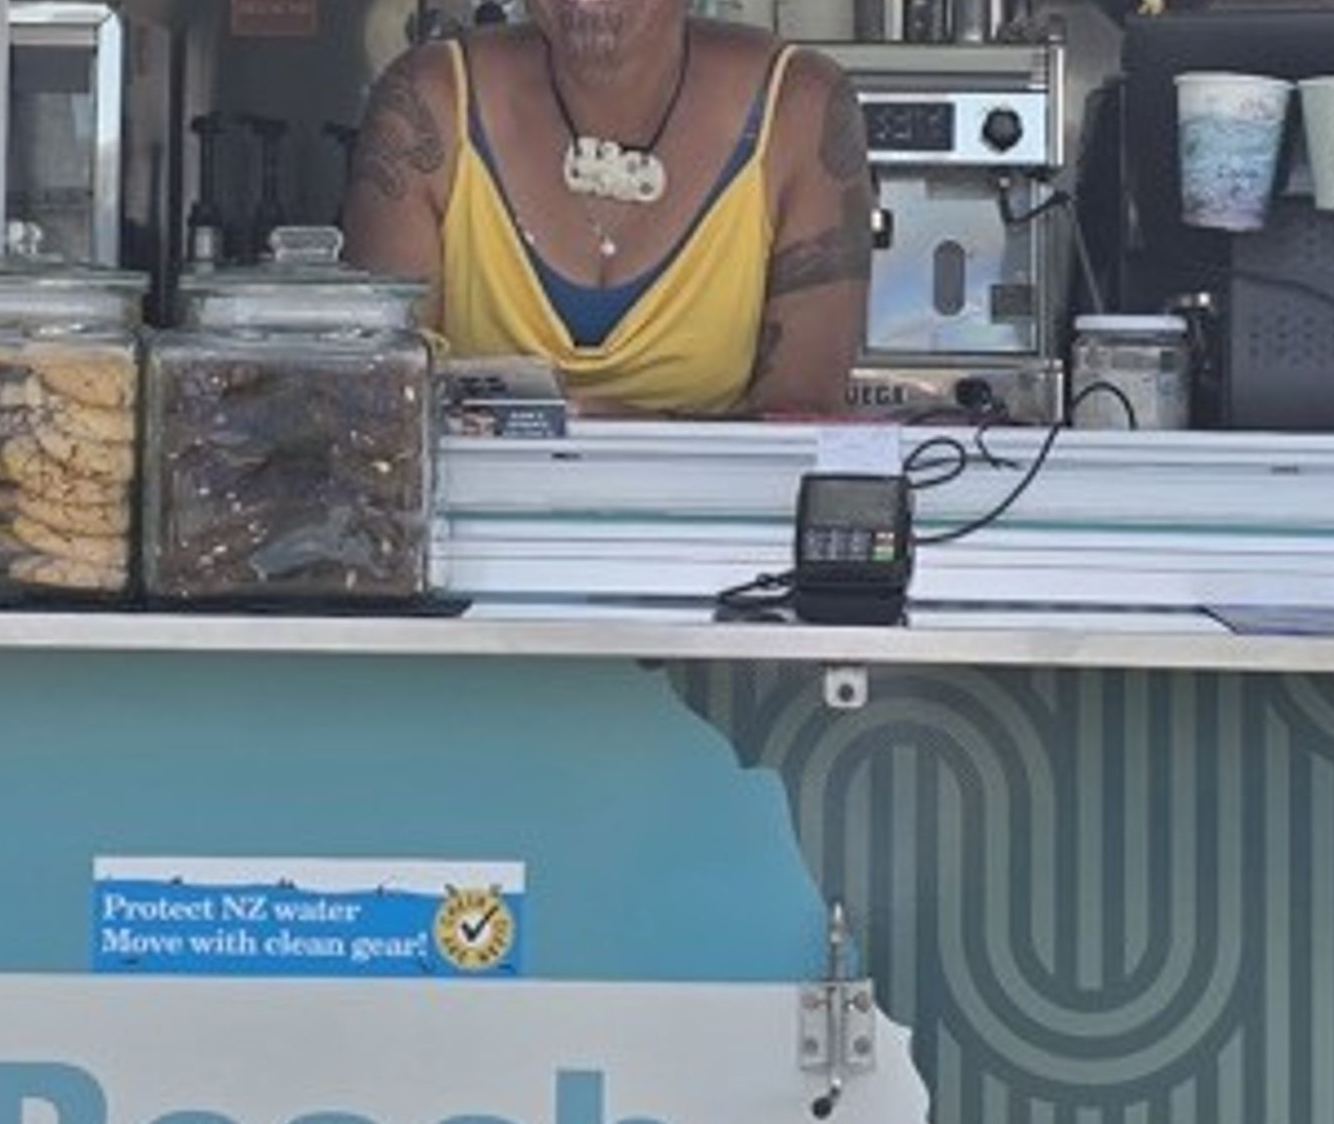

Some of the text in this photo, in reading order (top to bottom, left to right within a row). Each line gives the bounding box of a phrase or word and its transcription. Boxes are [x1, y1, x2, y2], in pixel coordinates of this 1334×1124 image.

[102, 894, 361, 924] Protect NZ water
[101, 928, 429, 962] Move with clean gear!
